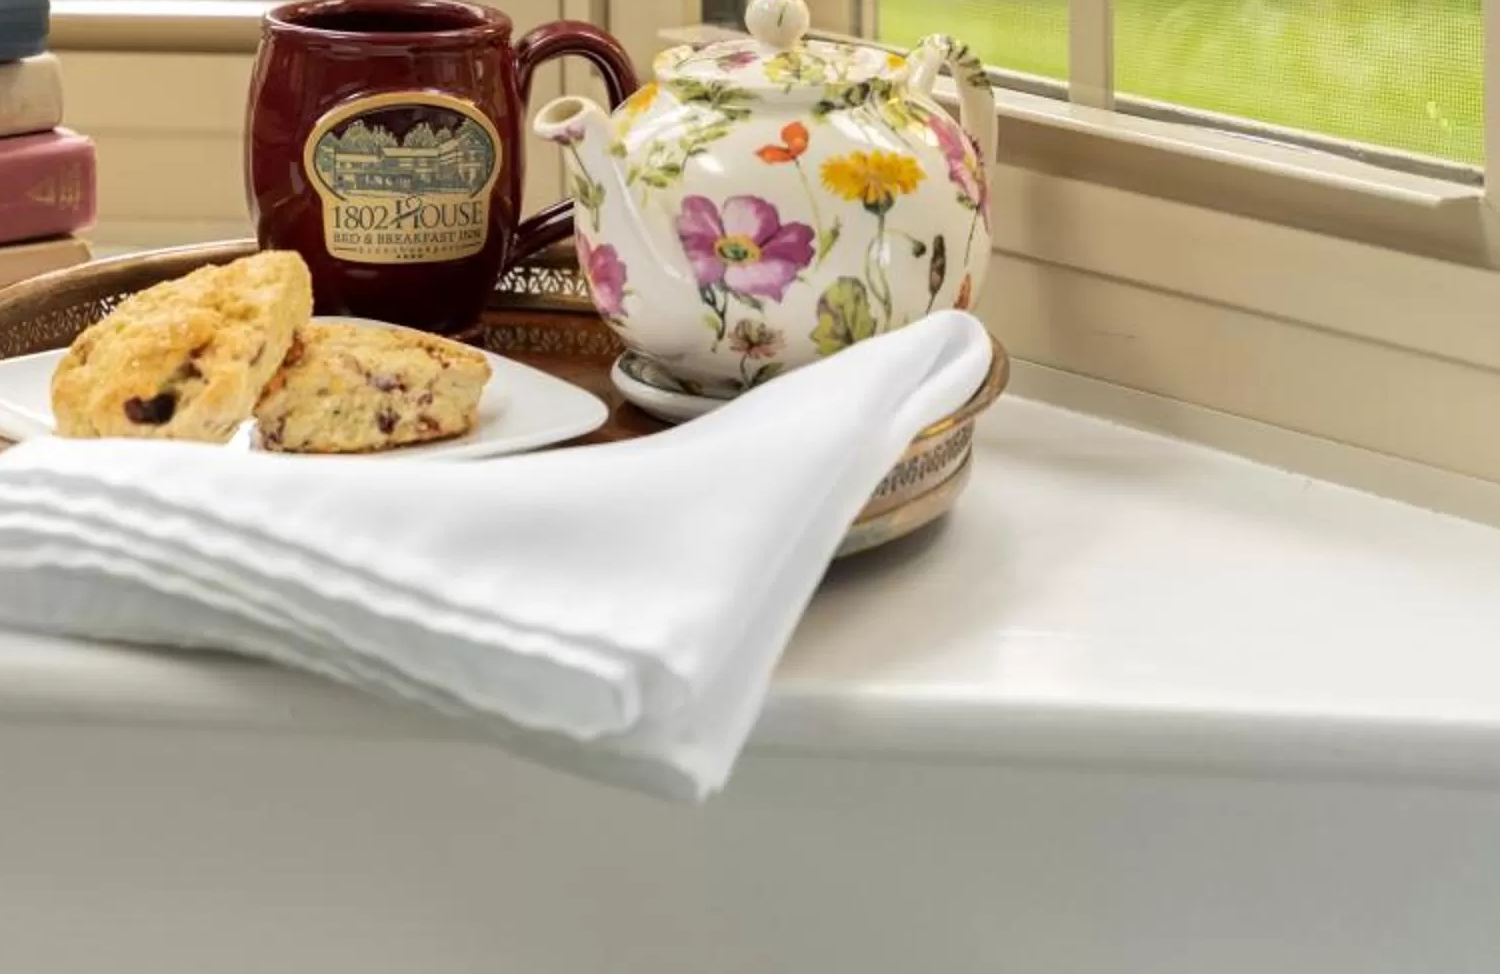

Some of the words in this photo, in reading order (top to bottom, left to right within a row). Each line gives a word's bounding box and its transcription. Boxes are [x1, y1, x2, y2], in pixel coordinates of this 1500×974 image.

[332, 205, 389, 230] 1802
[333, 232, 361, 244] BED
[363, 233, 373, 245] &
[377, 231, 456, 245] BREAKFAST
[459, 228, 481, 240] INN
